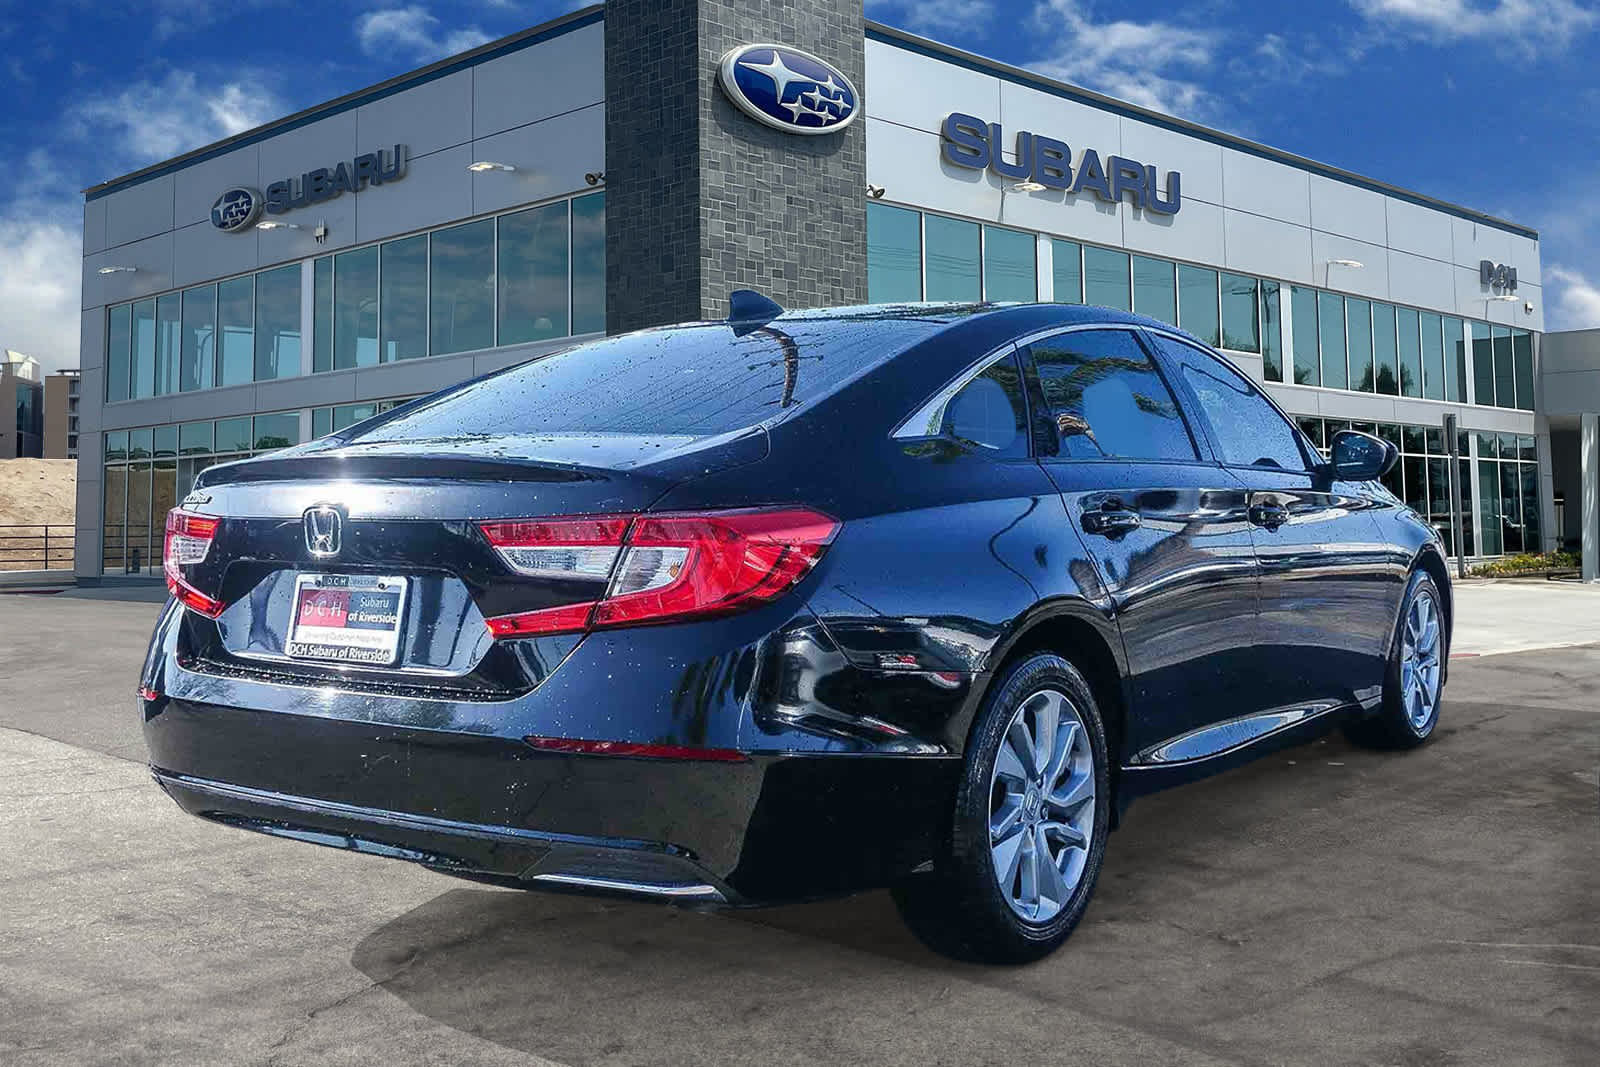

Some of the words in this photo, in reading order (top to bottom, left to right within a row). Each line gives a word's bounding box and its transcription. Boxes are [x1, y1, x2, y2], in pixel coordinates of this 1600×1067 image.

[942, 112, 1181, 215] SUBARU
[266, 144, 407, 214] SUBARU
[360, 597, 389, 609] Subaru
[348, 612, 359, 621] of
[359, 612, 397, 624] Riverside
[290, 643, 308, 655] DCH
[309, 645, 337, 657] Subaru
[338, 646, 349, 658] of
[349, 648, 391, 662] Riverside
